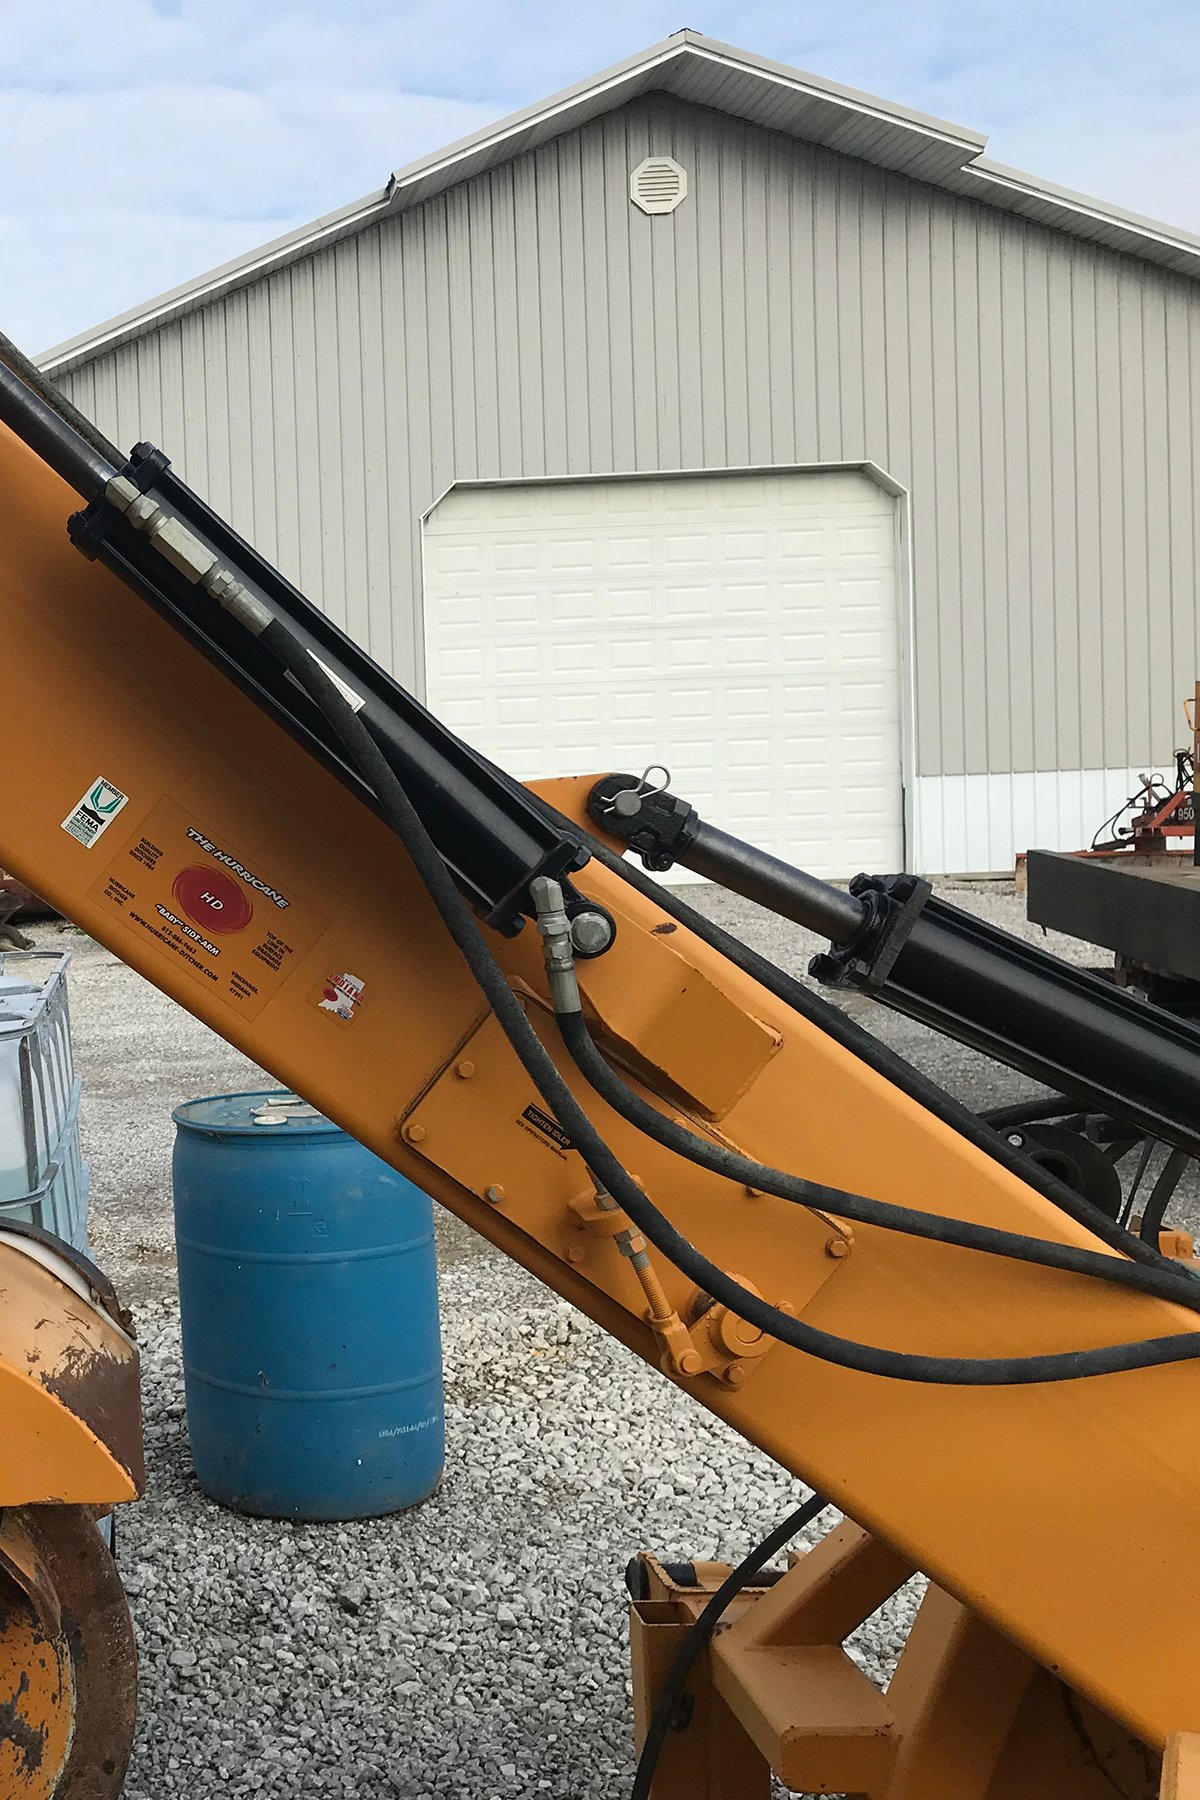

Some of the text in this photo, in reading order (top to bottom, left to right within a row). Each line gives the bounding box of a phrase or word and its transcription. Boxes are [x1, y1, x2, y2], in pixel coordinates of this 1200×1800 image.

[100, 780, 125, 800] MEMBER
[75, 810, 99, 832] FEMA
[1178, 807, 1195, 820] 950
[139, 843, 159, 859] QUALITY
[140, 837, 164, 856] BUILDING
[186, 827, 290, 909] THE HURRICANE
[108, 884, 128, 901] DITCHER
[109, 877, 135, 899] HURRICANE
[200, 891, 224, 910] HD
[182, 925, 219, 956] SIDE-ARM
[266, 932, 277, 940] TOP
[284, 944, 293, 954] THE
[527, 1110, 571, 1145] TIGHTEN IDLER
